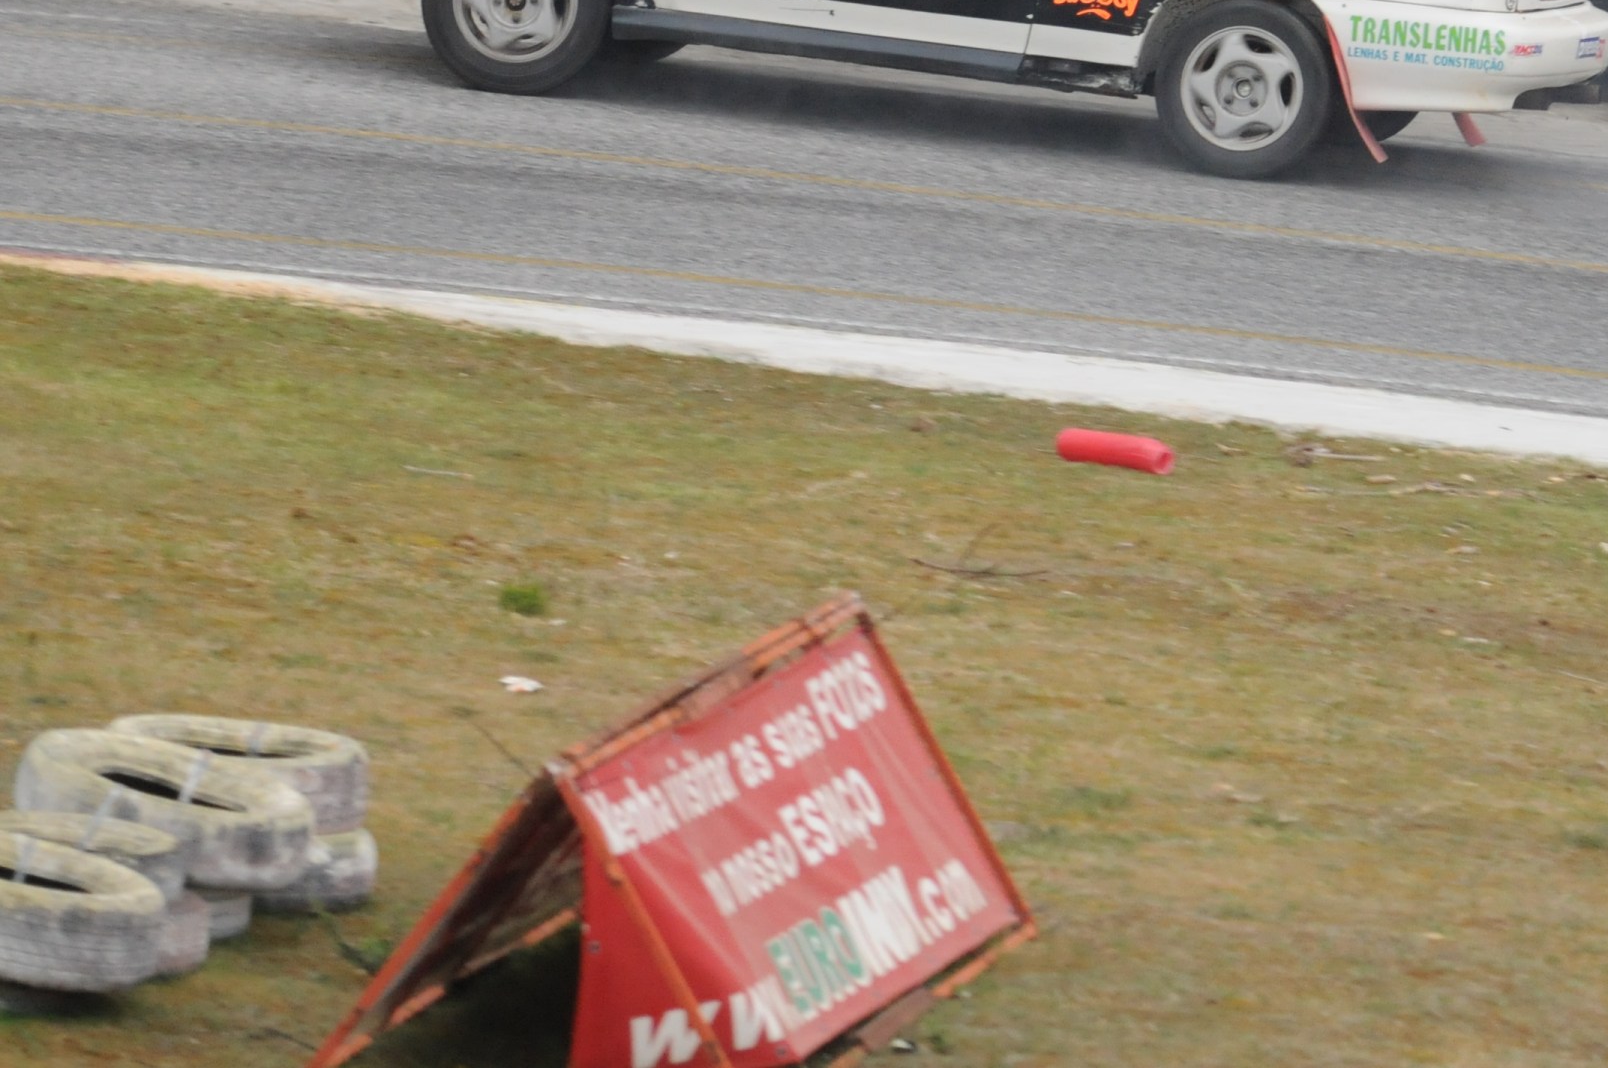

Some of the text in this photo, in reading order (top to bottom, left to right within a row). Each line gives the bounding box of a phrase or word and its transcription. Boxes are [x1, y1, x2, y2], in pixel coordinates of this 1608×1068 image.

[1350, 14, 1507, 56] TRANSLENHAS
[1347, 46, 1505, 73] LENHAS E MAT. CONSTRUÇÃO
[729, 733, 775, 790] as
[761, 703, 825, 769] suas
